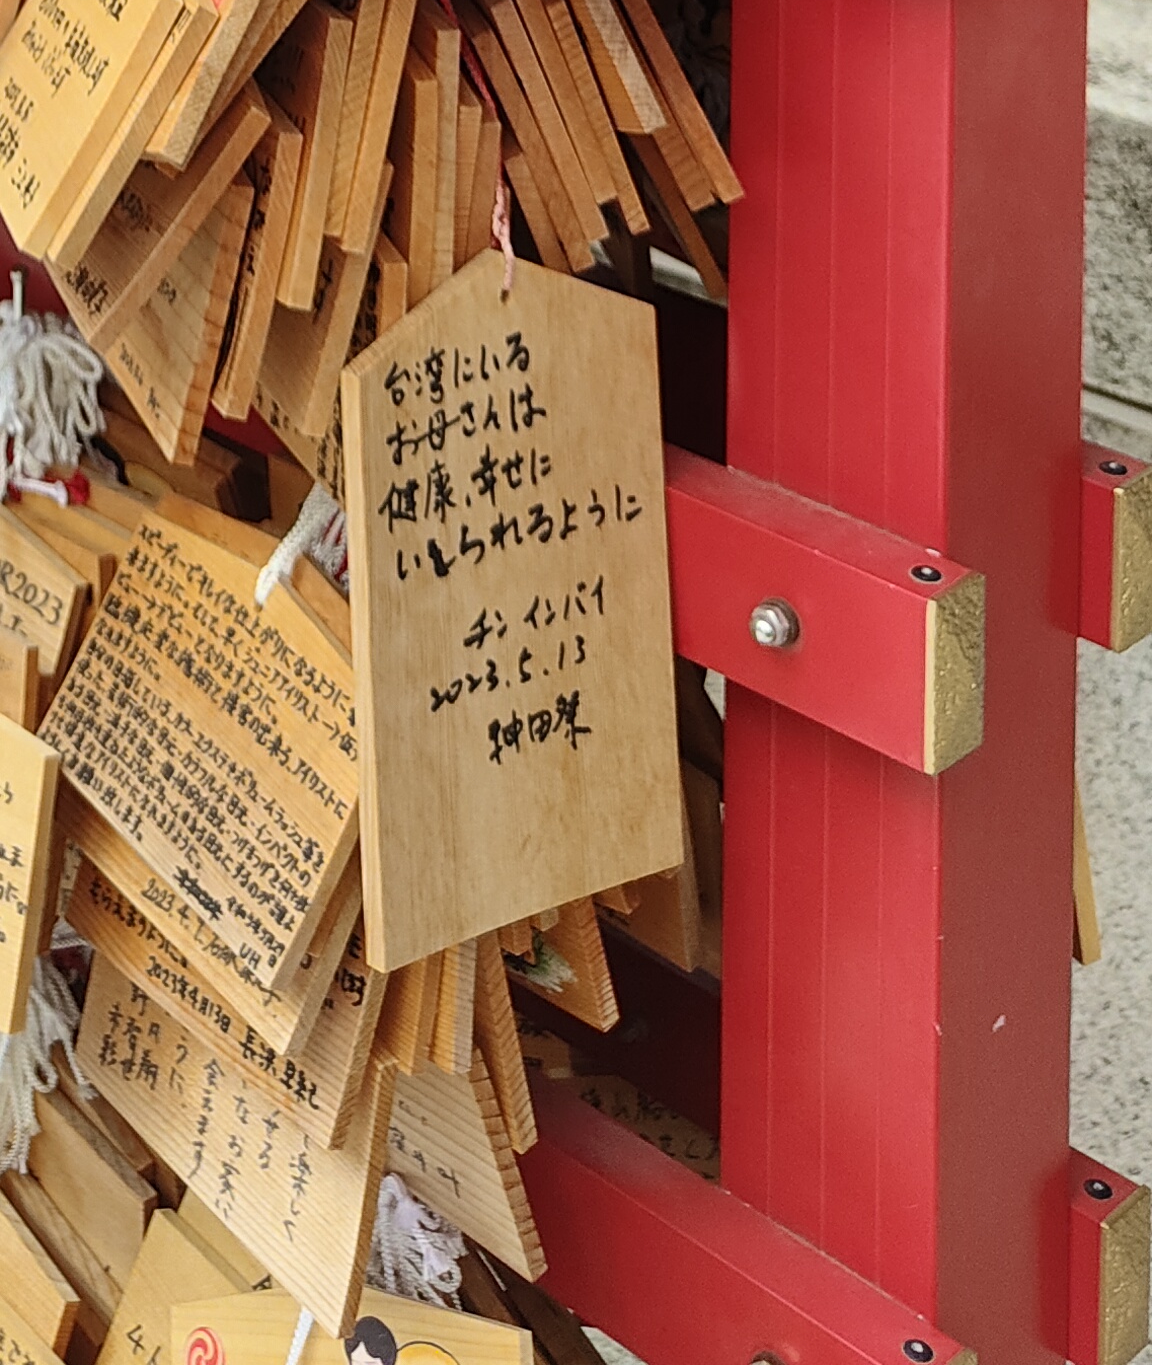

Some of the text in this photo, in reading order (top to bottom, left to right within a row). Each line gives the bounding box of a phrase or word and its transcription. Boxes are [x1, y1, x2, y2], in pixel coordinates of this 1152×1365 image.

[383, 332, 532, 408] 台湾にいる
[385, 388, 548, 468] お母さんは
[429, 635, 587, 713] 2023.5.13
